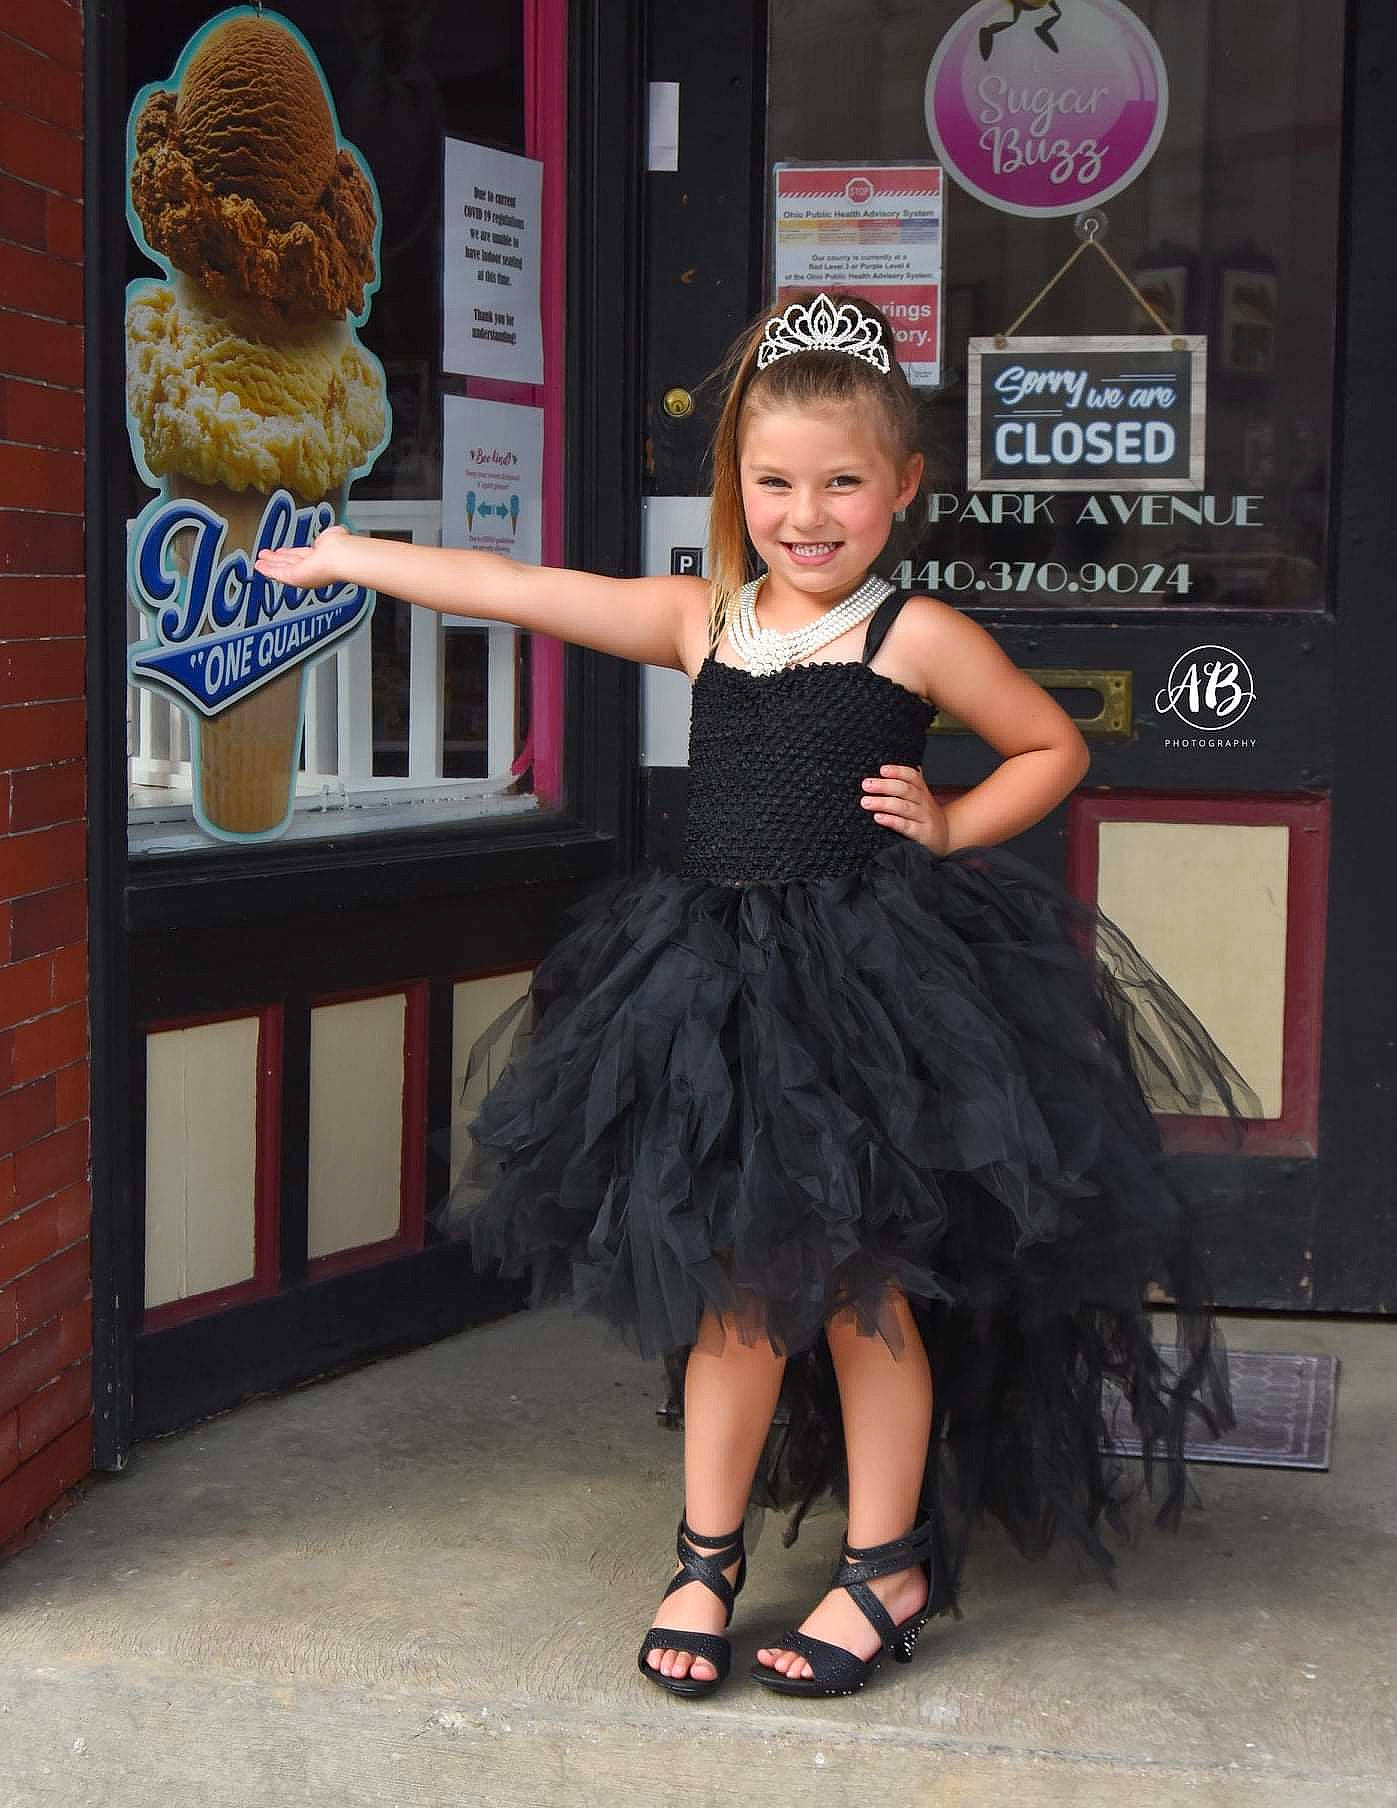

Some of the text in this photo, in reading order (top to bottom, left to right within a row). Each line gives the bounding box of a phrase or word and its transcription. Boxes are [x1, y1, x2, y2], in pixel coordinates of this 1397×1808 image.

[977, 75, 1108, 137] Sugar
[979, 126, 1109, 185] Buzz
[464, 204, 482, 220] COVID
[484, 209, 491, 222] 19
[806, 210, 832, 218] Public
[834, 209, 861, 217] Health
[863, 209, 900, 219] Advisory
[903, 208, 934, 219] System
[465, 246, 480, 260] have
[885, 262, 905, 270] Level
[474, 309, 493, 323] Thank
[994, 365, 1176, 408] Sorry we are
[995, 421, 1176, 465] CLOSED
[928, 493, 1055, 523] PARK
[1076, 495, 1264, 526] AVENUE
